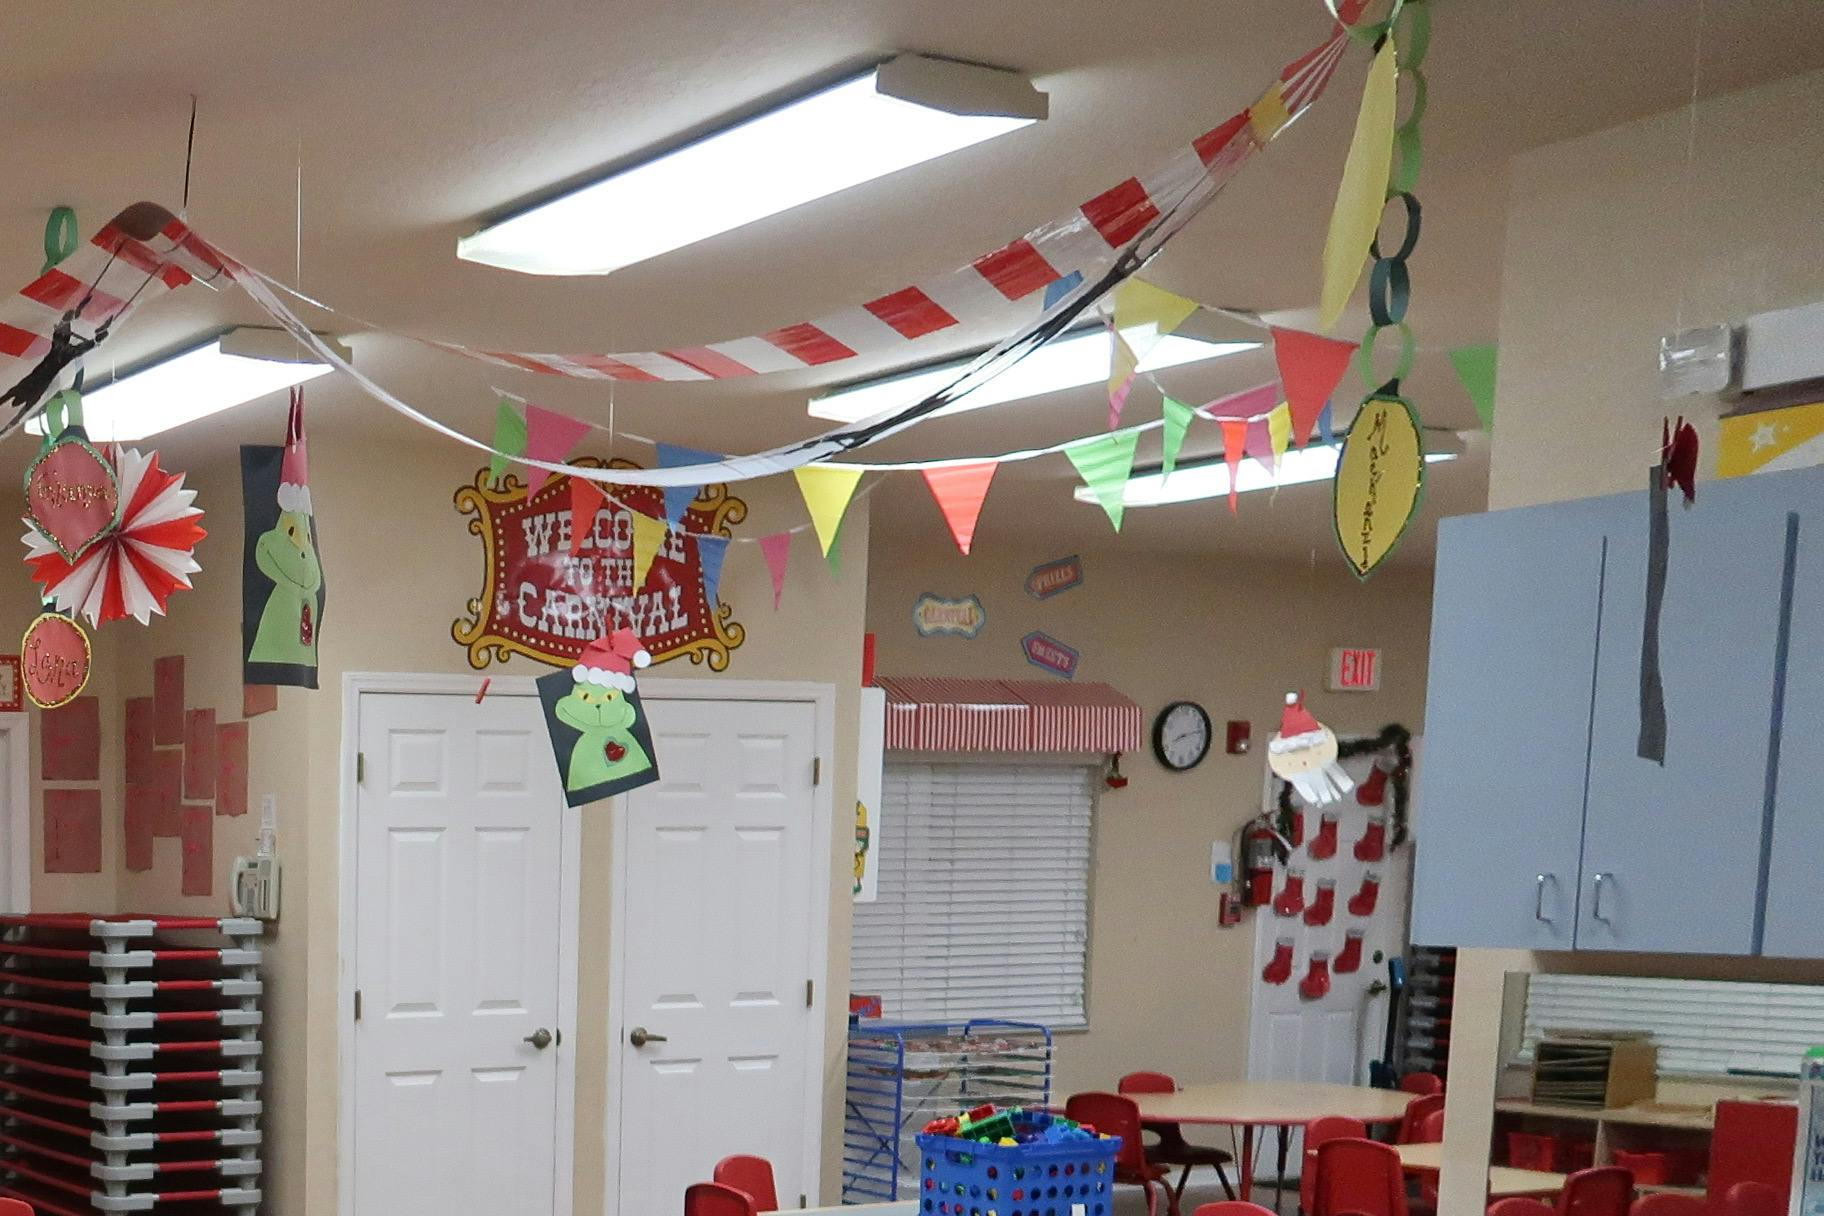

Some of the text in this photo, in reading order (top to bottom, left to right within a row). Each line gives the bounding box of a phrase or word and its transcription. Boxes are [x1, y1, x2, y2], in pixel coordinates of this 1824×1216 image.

[522, 508, 687, 564] WECOE
[565, 557, 645, 588] TO TH
[519, 581, 688, 641] CARNIVAL
[1341, 649, 1376, 686] EXIT
